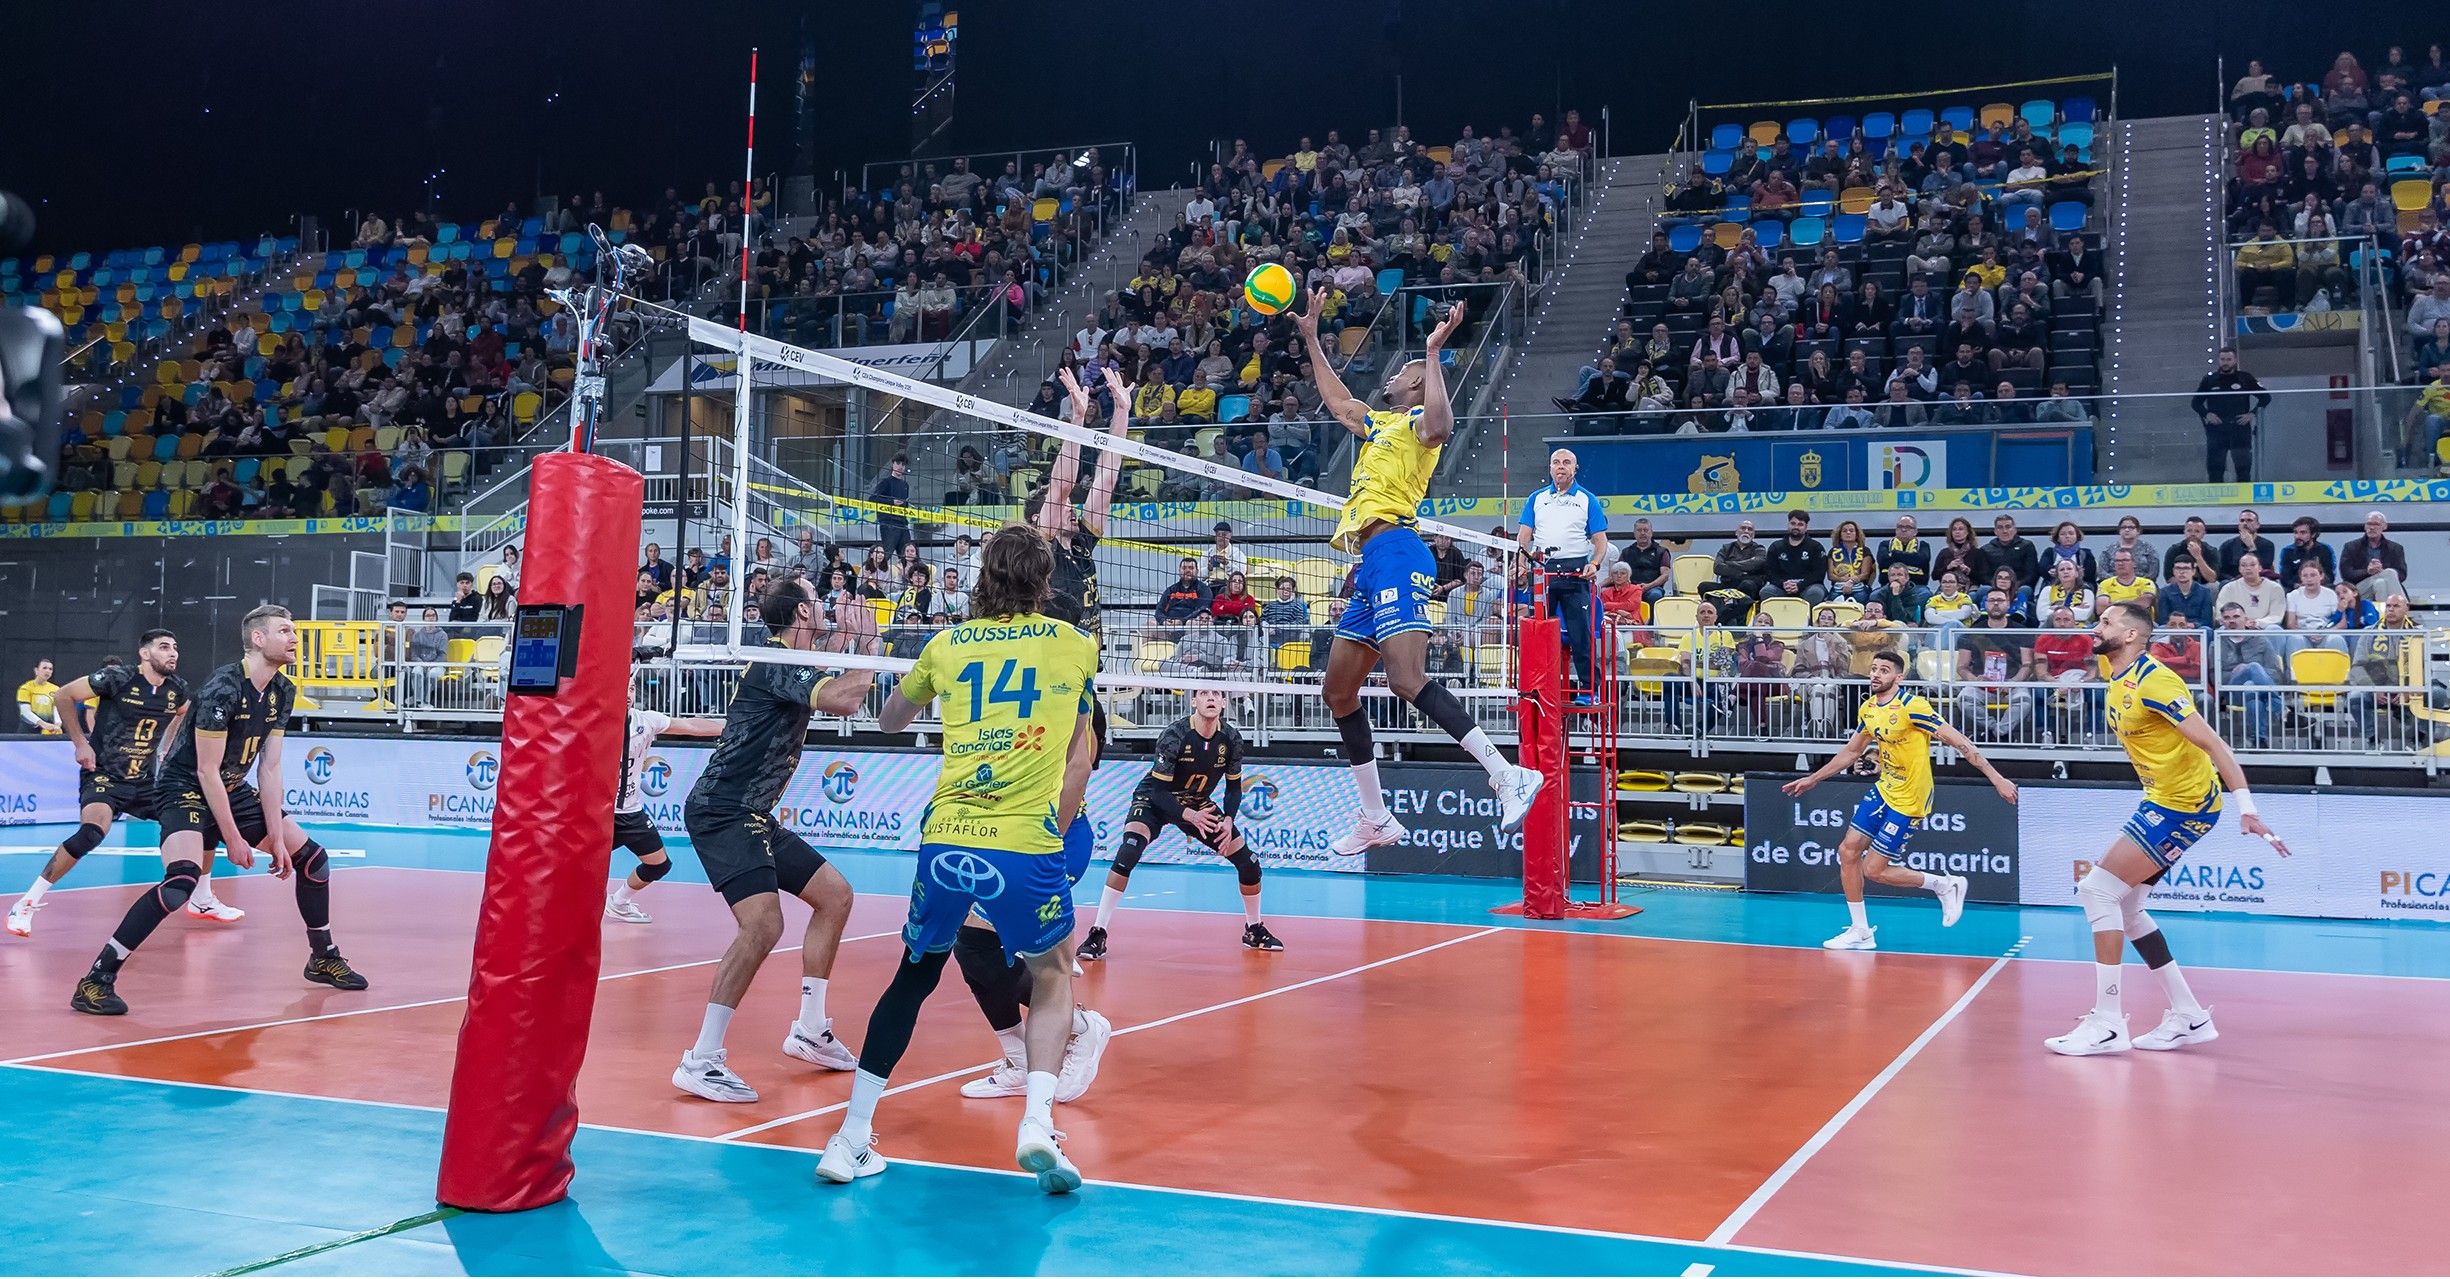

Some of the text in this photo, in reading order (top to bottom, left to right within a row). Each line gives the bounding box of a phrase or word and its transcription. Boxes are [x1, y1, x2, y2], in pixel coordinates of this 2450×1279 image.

[790, 351, 805, 363] CEV
[964, 399, 976, 409] CEV
[951, 623, 1058, 646] ROUSSEAUX
[956, 659, 1042, 722] 14
[134, 718, 157, 741] 13
[978, 728, 1013, 740] Islas
[951, 741, 1012, 754] Canarias
[189, 812, 200, 823] 15
[780, 807, 901, 830] PICANARIAS
[1794, 803, 1844, 827] Las
[929, 823, 998, 837] VISTAFLOR
[871, 833, 901, 841] Canarias
[1389, 824, 1483, 853] eague
[1295, 852, 1329, 862] Canarias
[1752, 841, 1789, 864] de
[2203, 892, 2216, 900] de
[2219, 893, 2265, 903] Canarias
[2381, 899, 2450, 910] Profesionales
